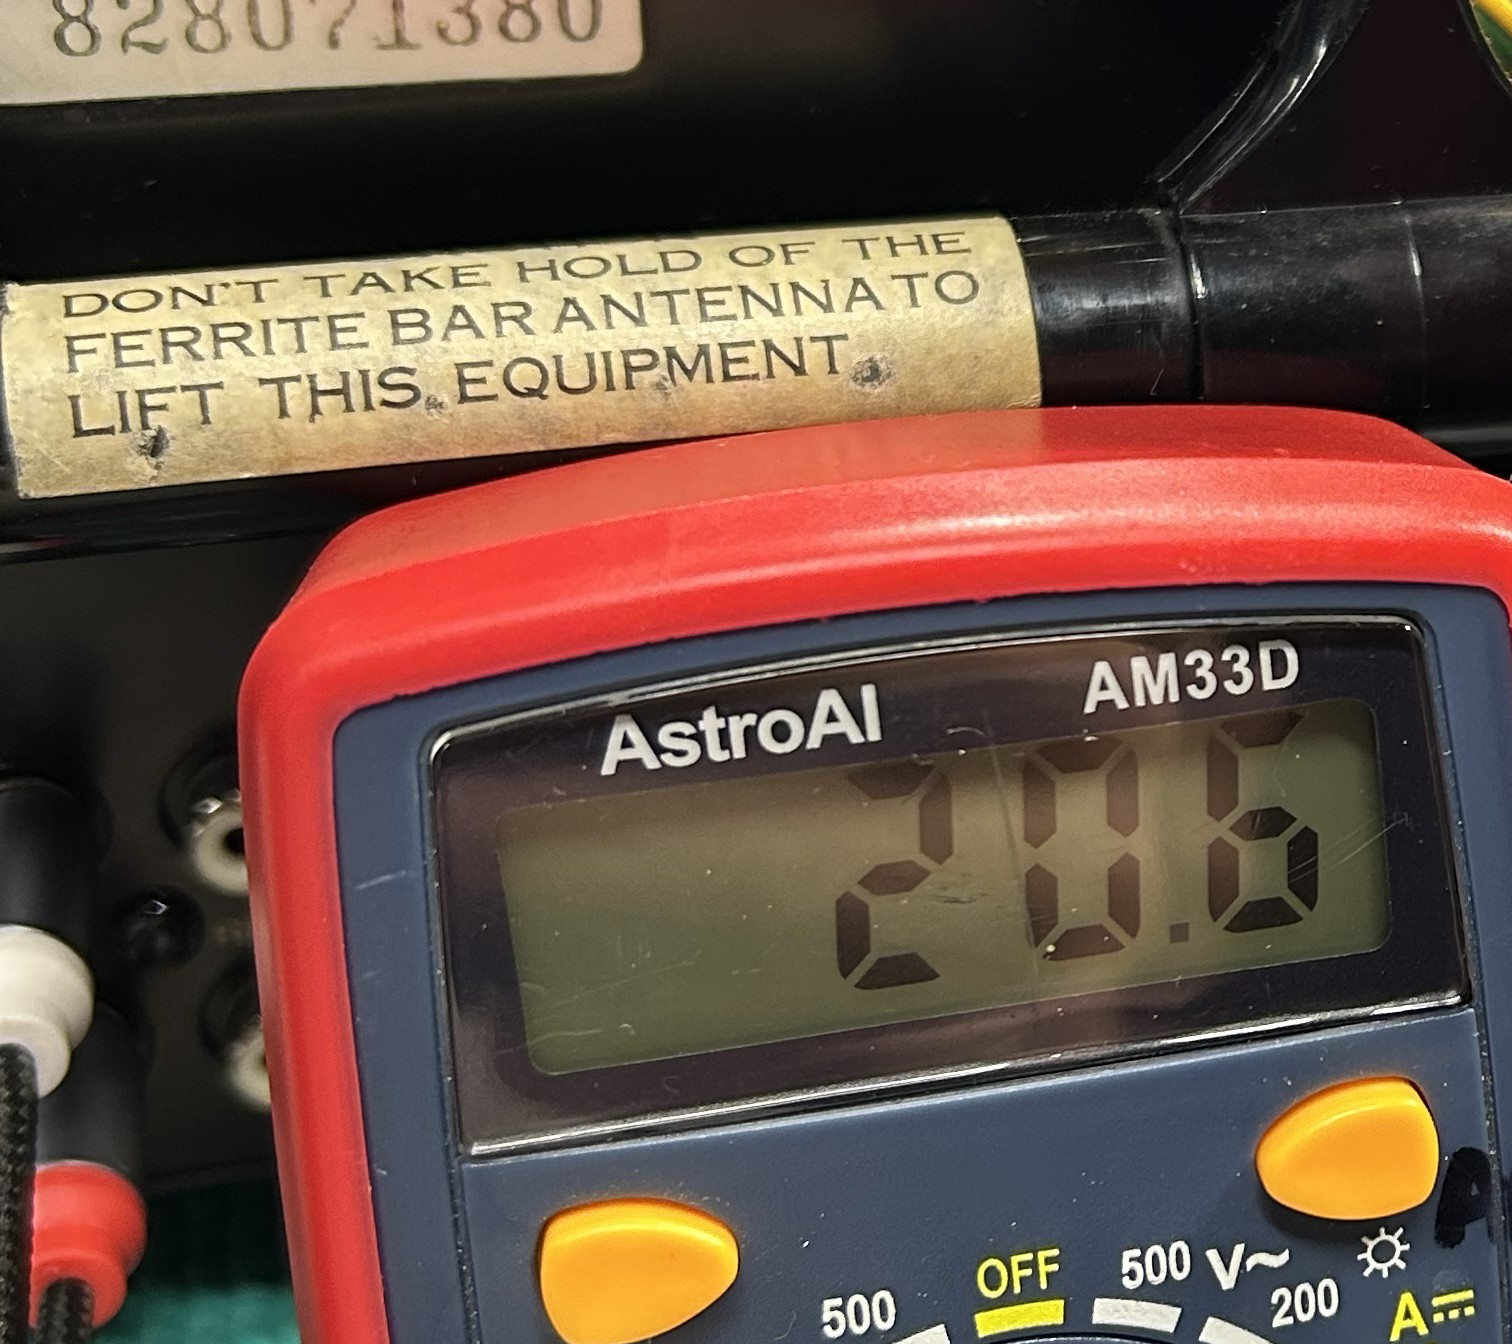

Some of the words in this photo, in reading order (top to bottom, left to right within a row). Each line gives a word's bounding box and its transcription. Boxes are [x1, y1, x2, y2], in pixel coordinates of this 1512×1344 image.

[62, 278, 279, 319] DON'T
[303, 263, 492, 299] TAKE
[516, 249, 703, 284] HOLD
[728, 241, 816, 268] OF
[841, 231, 973, 261] THE
[64, 311, 369, 374] FERRITE
[388, 301, 535, 347] BAR
[554, 276, 886, 334] ANTENNA
[890, 269, 980, 309] TO
[67, 380, 225, 439] LIFT
[259, 366, 423, 423] THIS
[454, 333, 849, 404] EQUIPMENT
[598, 683, 884, 776] AstroAI
[1081, 637, 1300, 716] AM33D
[835, 709, 1319, 992] 20.6
[975, 1248, 1061, 1299] OFF
[1121, 1239, 1192, 1291] 500
[1270, 1277, 1340, 1329] 200
[821, 1289, 897, 1339] 500
